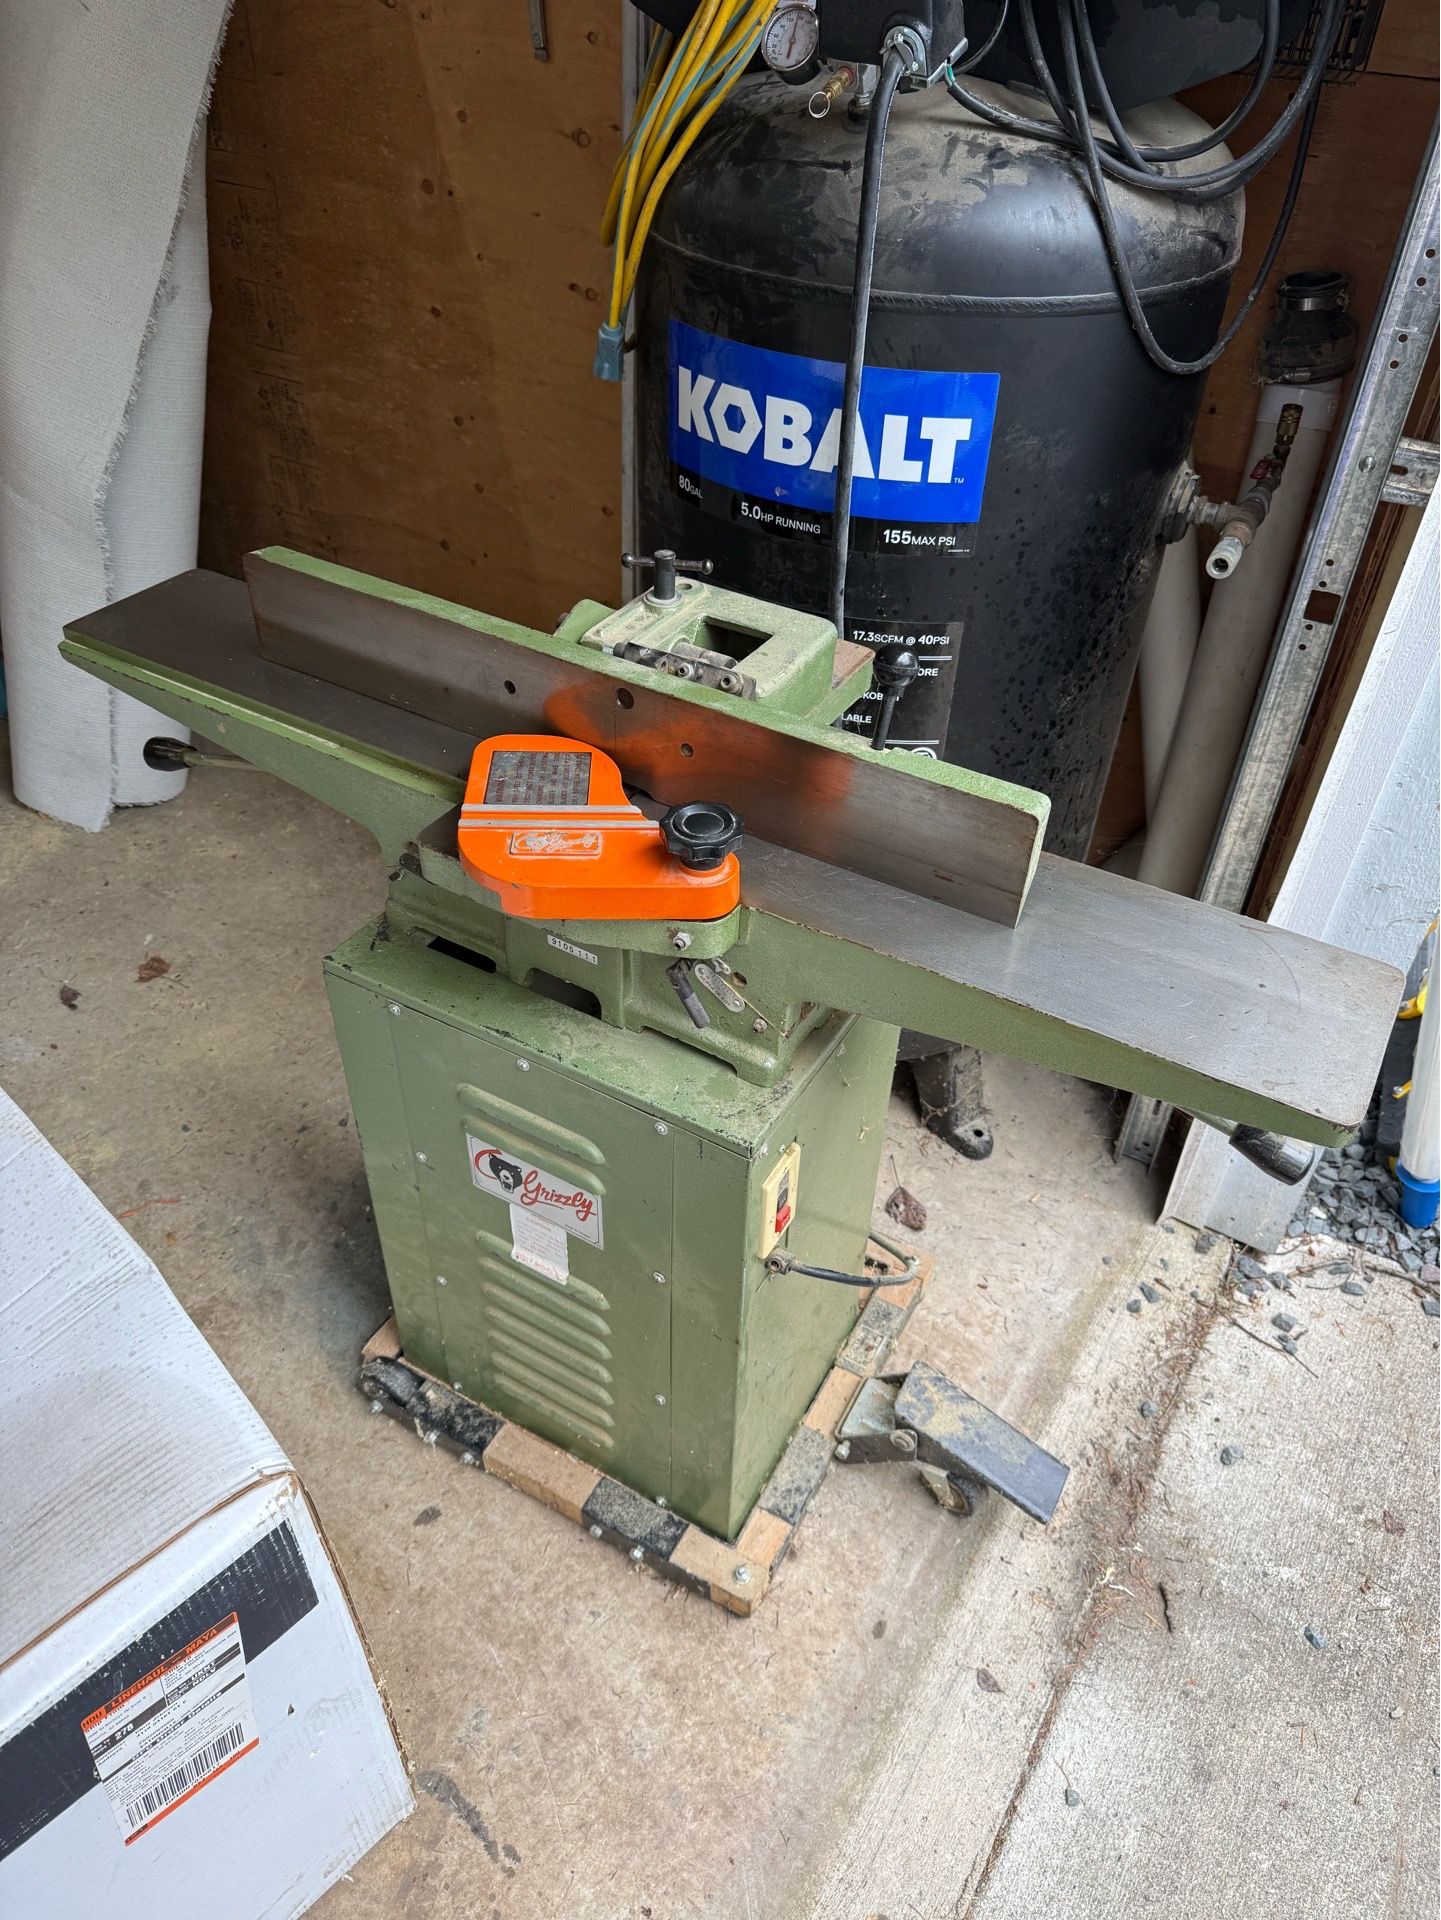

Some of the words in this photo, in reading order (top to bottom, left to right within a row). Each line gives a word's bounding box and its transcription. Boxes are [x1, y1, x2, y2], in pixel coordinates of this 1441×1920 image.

[677, 364, 972, 484] KOBALT
[775, 516, 821, 534] RUNNING
[882, 529, 936, 547] 155MAX
[938, 535, 956, 547] PSI
[853, 630, 904, 644] 17.3SCFM
[905, 636, 916, 646] @
[917, 634, 950, 645] 40PSI
[917, 668, 939, 677] ORE
[842, 713, 872, 723] LABLE
[551, 937, 574, 953] 9105
[519, 1169, 597, 1222] Grizzly
[82, 1710, 104, 1729] HDU
[111, 1665, 168, 1709] LINEHAUL
[185, 1629, 218, 1655] MAYA
[114, 1722, 135, 1741] 278
